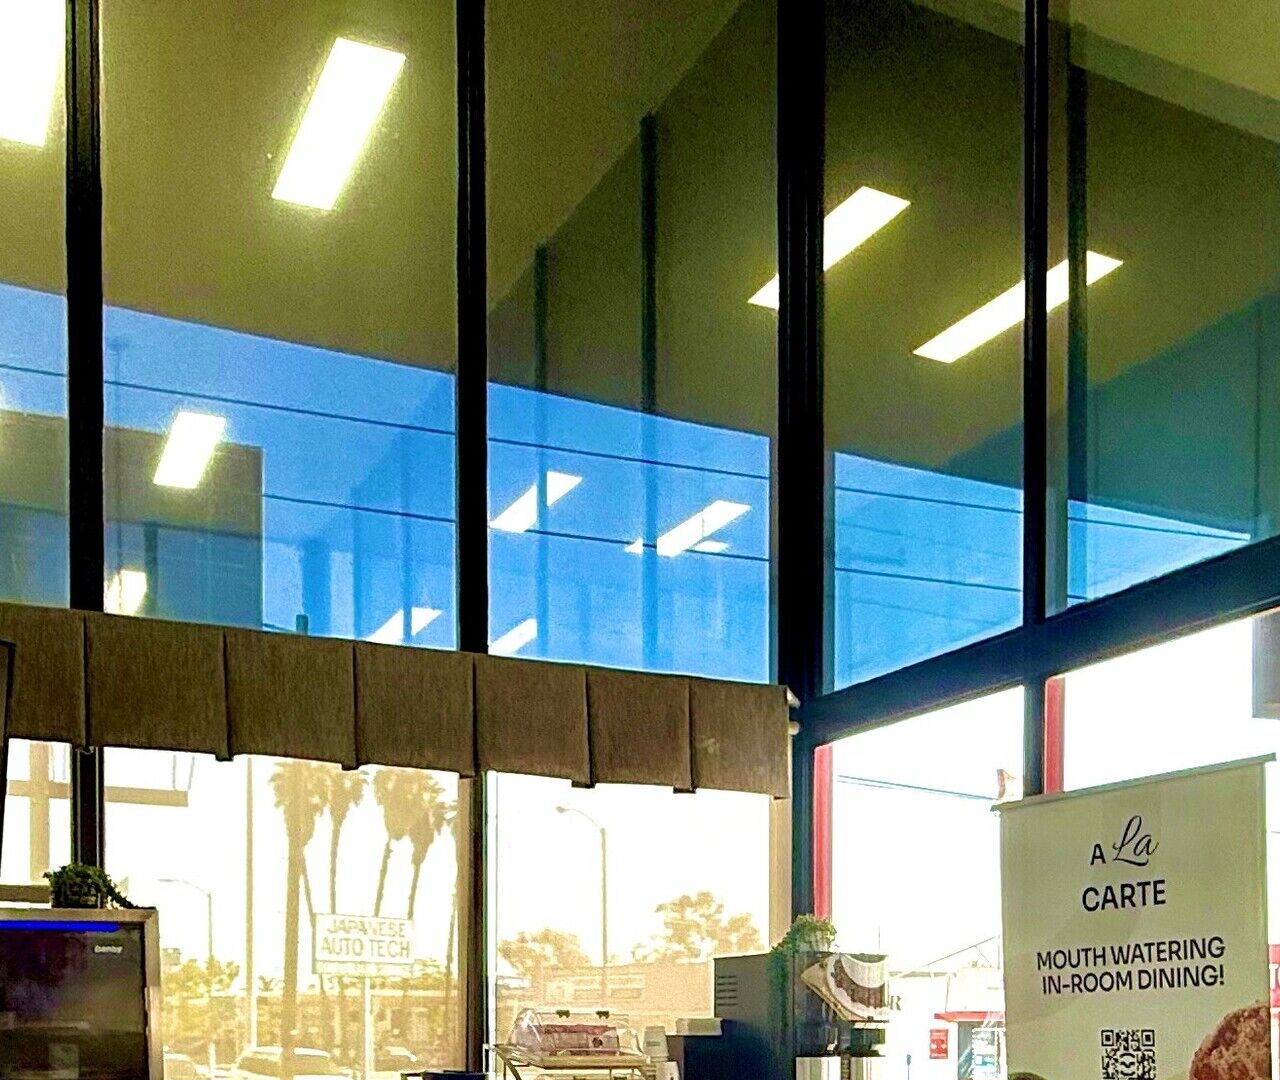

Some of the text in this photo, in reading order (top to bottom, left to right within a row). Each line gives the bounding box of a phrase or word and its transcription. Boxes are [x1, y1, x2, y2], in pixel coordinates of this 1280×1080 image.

[1090, 815, 1159, 867] A La
[1081, 879, 1166, 912] CARTE
[326, 918, 406, 938] JAPANESE
[320, 936, 411, 958] AUTO TECH
[1036, 936, 1226, 971] MOUTH WATERING
[1041, 964, 1225, 995] IN-ROOM DINING!
